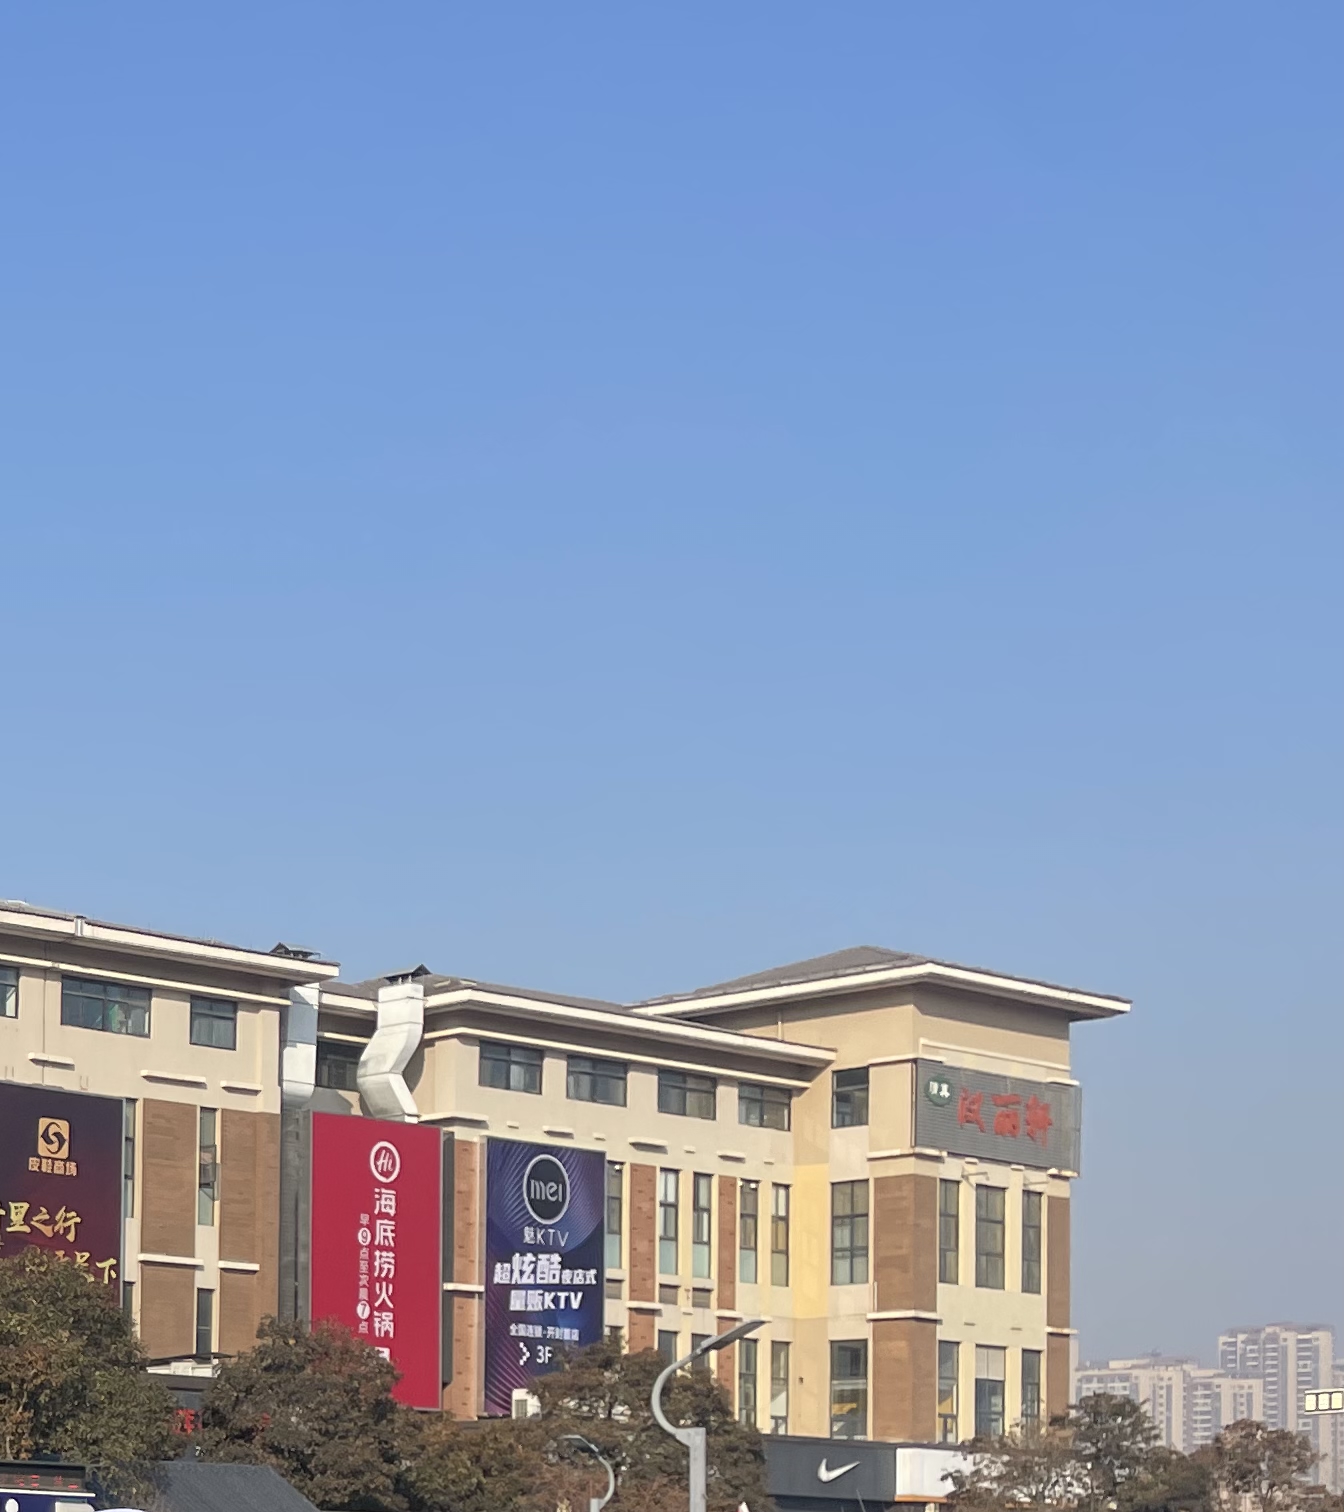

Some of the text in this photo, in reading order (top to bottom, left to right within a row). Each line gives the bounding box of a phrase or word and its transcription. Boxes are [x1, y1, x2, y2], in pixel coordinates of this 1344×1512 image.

[374, 1187, 396, 1339] 海底捞火锅
